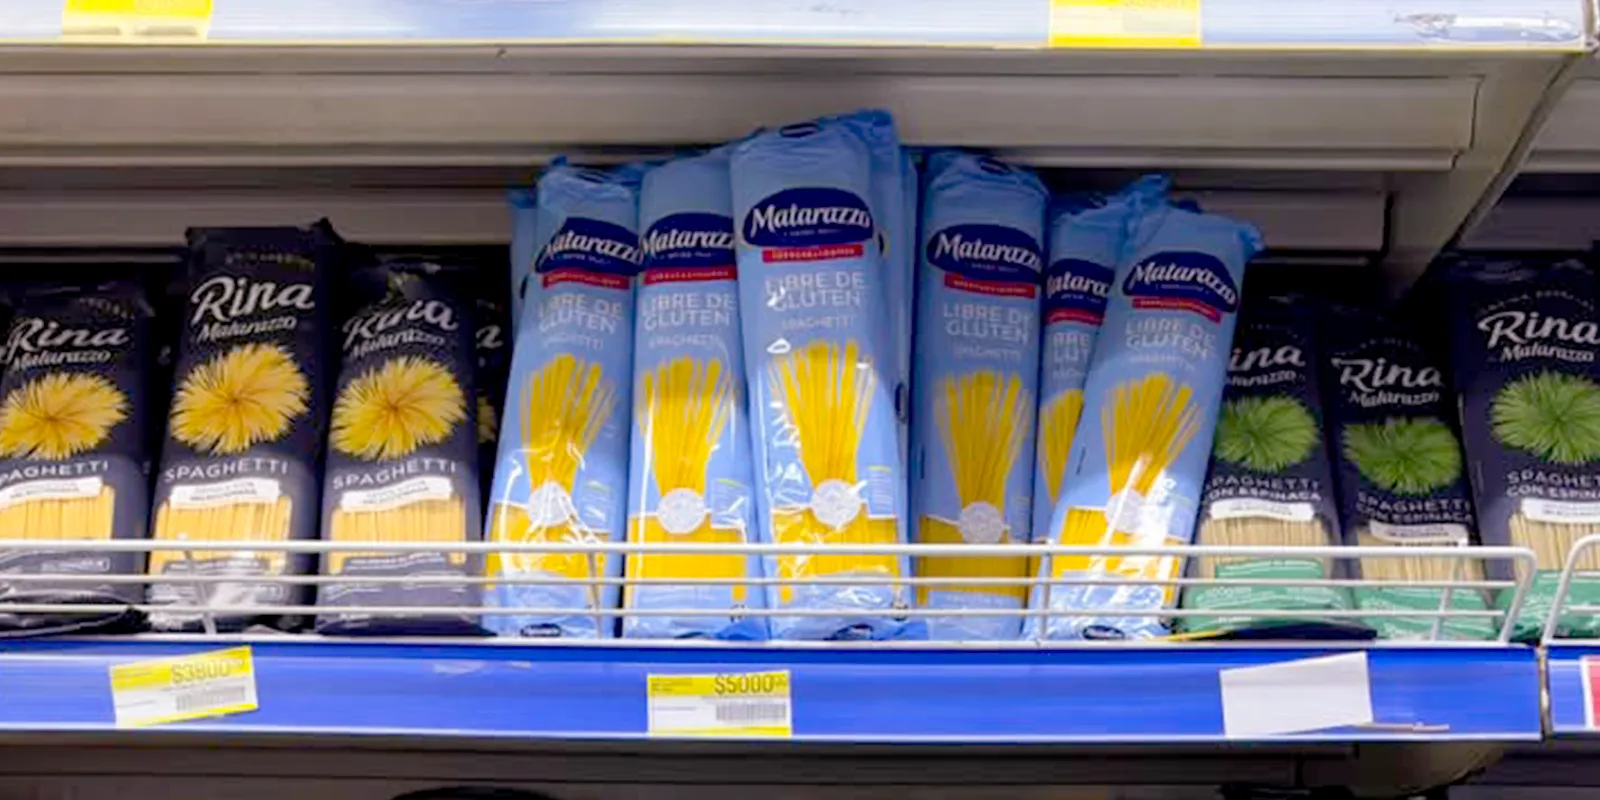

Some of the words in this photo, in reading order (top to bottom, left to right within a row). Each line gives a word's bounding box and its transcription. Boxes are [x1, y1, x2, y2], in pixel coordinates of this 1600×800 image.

[750, 203, 871, 238] Matarazzo
[642, 227, 736, 257] Matarazz
[836, 271, 868, 290] DE
[1128, 259, 1239, 306] Matarazzo
[191, 276, 316, 325] Rina
[942, 303, 1002, 322] LIBRE
[643, 309, 732, 332] GLUTEN
[945, 319, 1031, 346] GLUTEN
[1478, 311, 1600, 348] Rina
[1, 318, 130, 363] Rina
[1229, 345, 1306, 372] ina
[1331, 356, 1447, 392] Rina
[0, 459, 109, 485] PAGHETTI
[164, 457, 289, 483] SPAGHETTI
[332, 457, 457, 489] SPAGHETTI
[1507, 471, 1600, 488] SPAGHET
[1208, 487, 1234, 499] ON
[1507, 485, 1544, 497] CON
[714, 673, 774, 695] $5000
